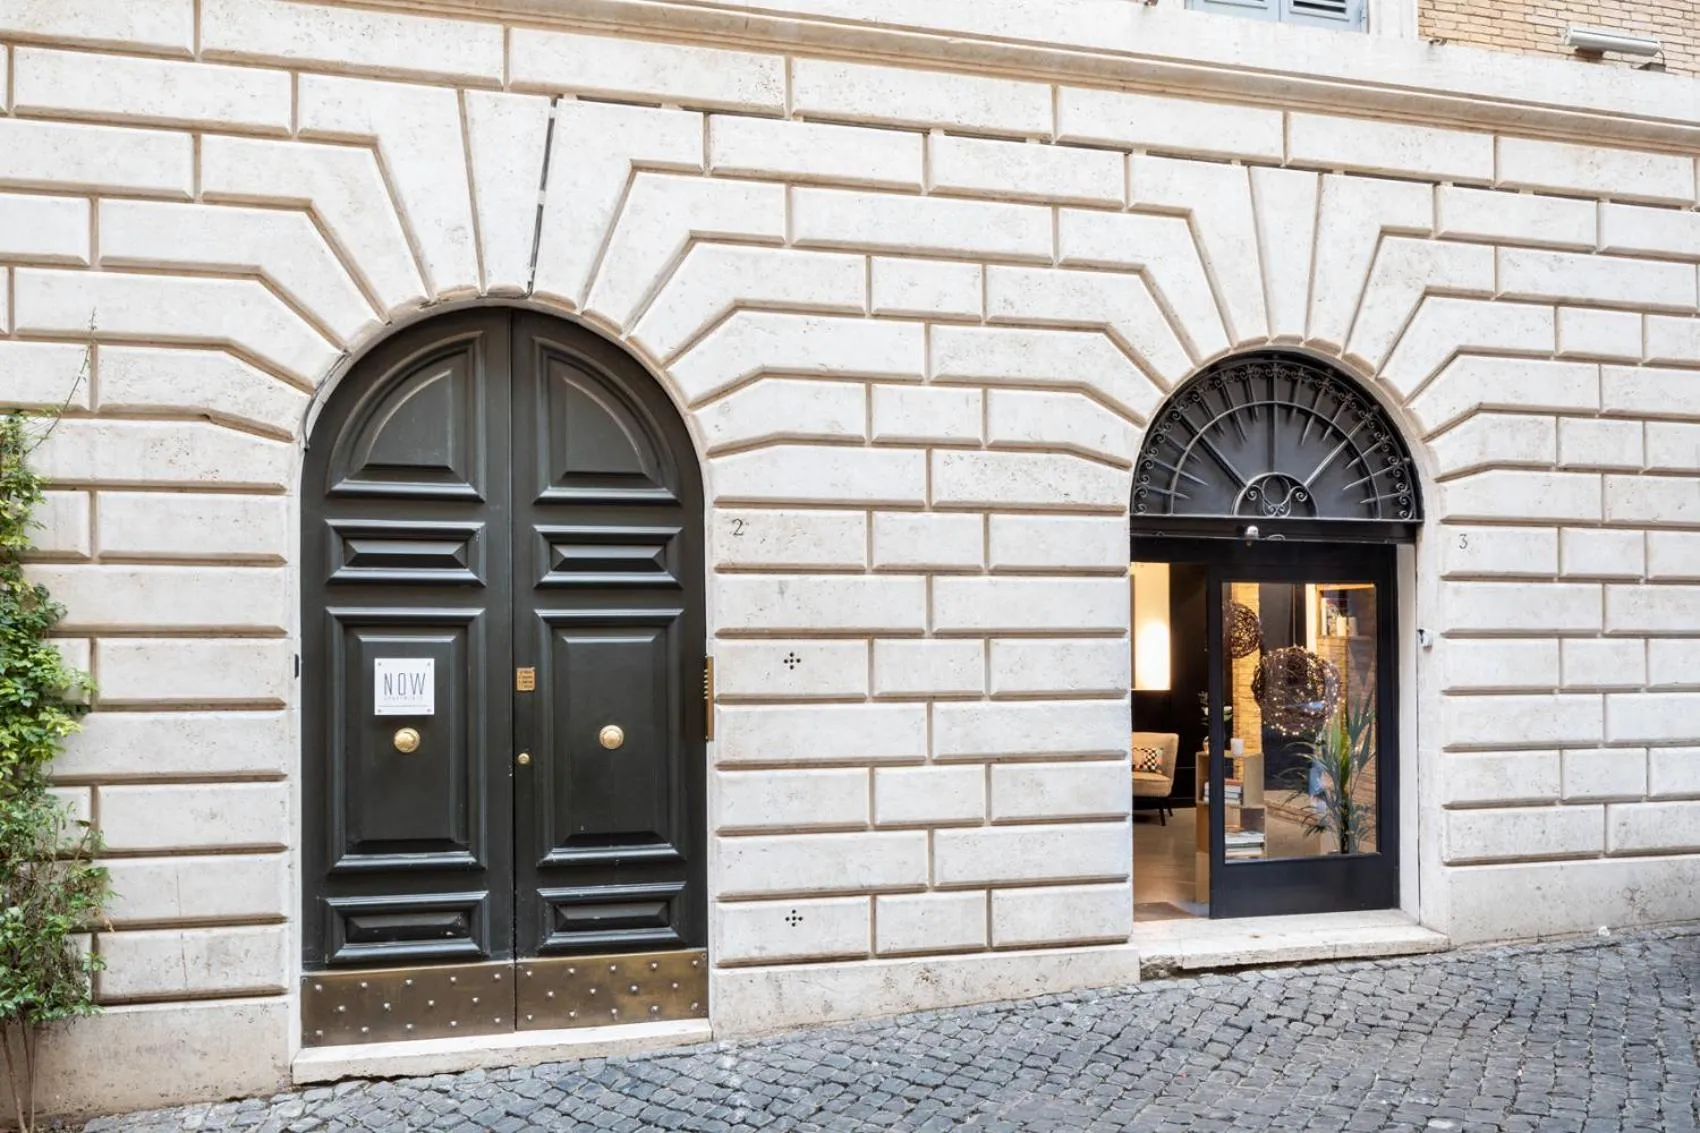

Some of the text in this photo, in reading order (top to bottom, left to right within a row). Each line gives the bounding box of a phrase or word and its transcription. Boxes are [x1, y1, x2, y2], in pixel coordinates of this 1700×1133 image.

[731, 518, 744, 536] 2
[1459, 533, 1468, 549] 3
[384, 672, 426, 695] NOW
